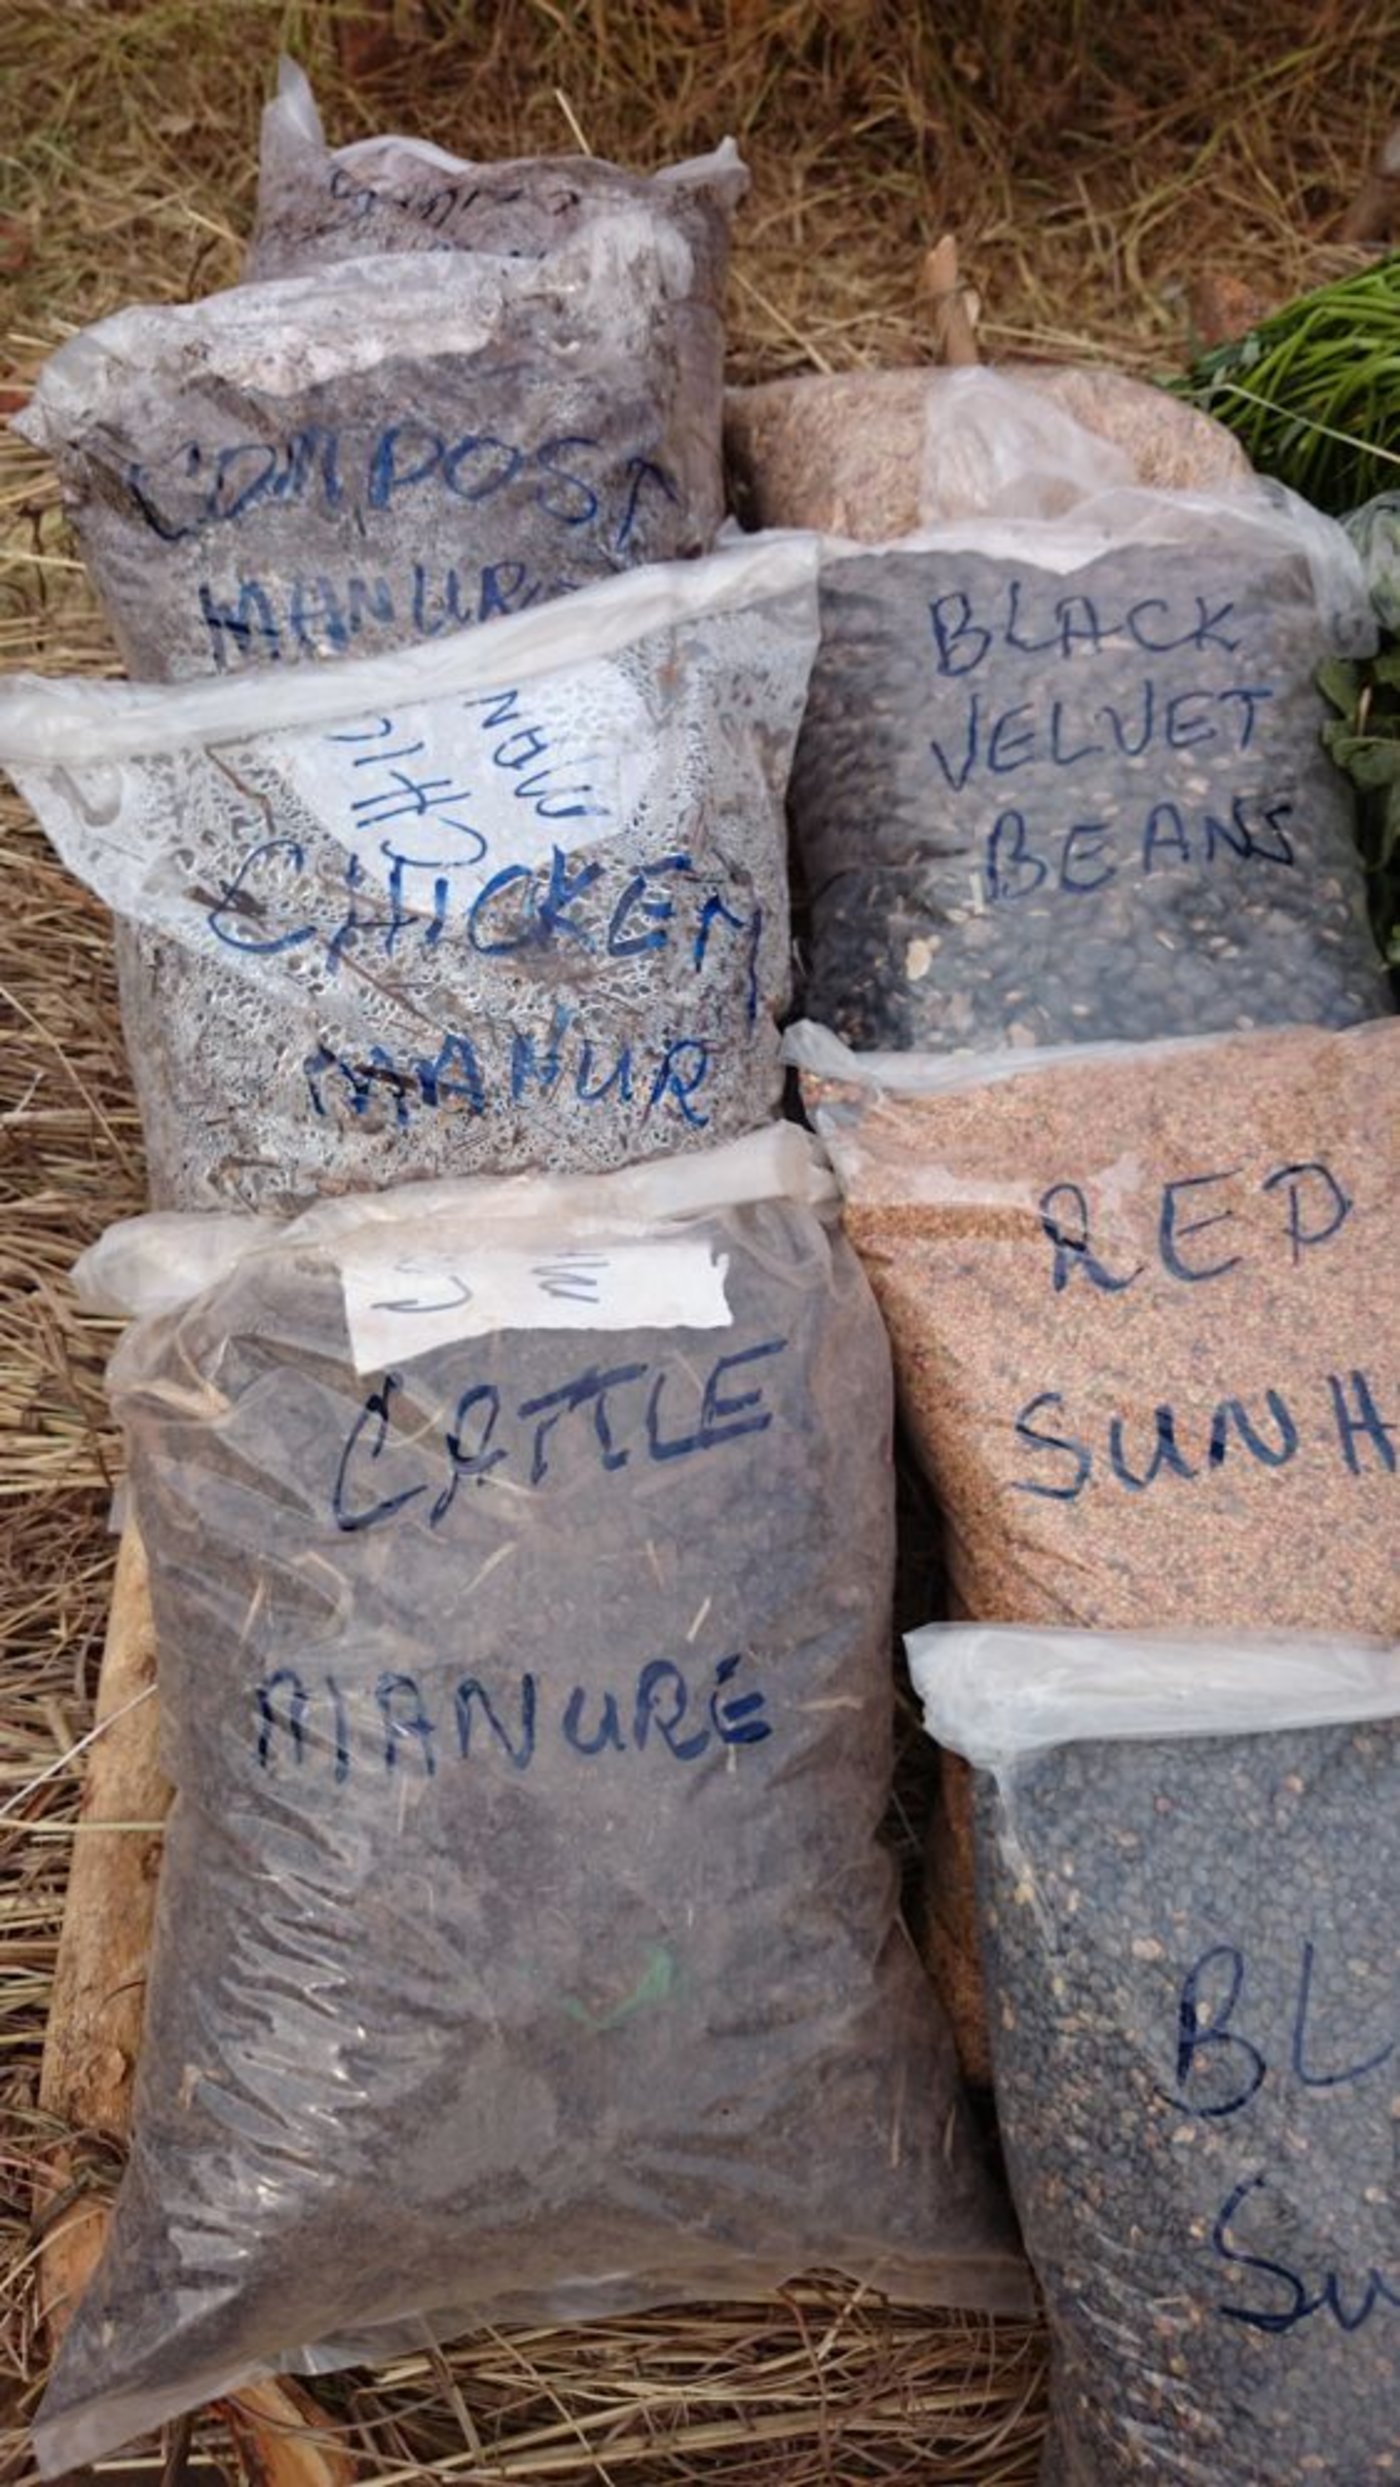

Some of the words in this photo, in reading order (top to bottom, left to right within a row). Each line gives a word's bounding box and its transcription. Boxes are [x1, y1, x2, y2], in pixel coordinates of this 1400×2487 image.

[200, 562, 581, 672] MANUR
[929, 581, 1241, 677] BLACK
[930, 680, 1273, 792] VELVET
[985, 795, 1295, 900] BEANS
[1039, 1162, 1354, 1292] RED
[332, 1337, 789, 1533] CATTLE
[1011, 1368, 1399, 1502] SUNH
[254, 1653, 774, 1784] MANURE
